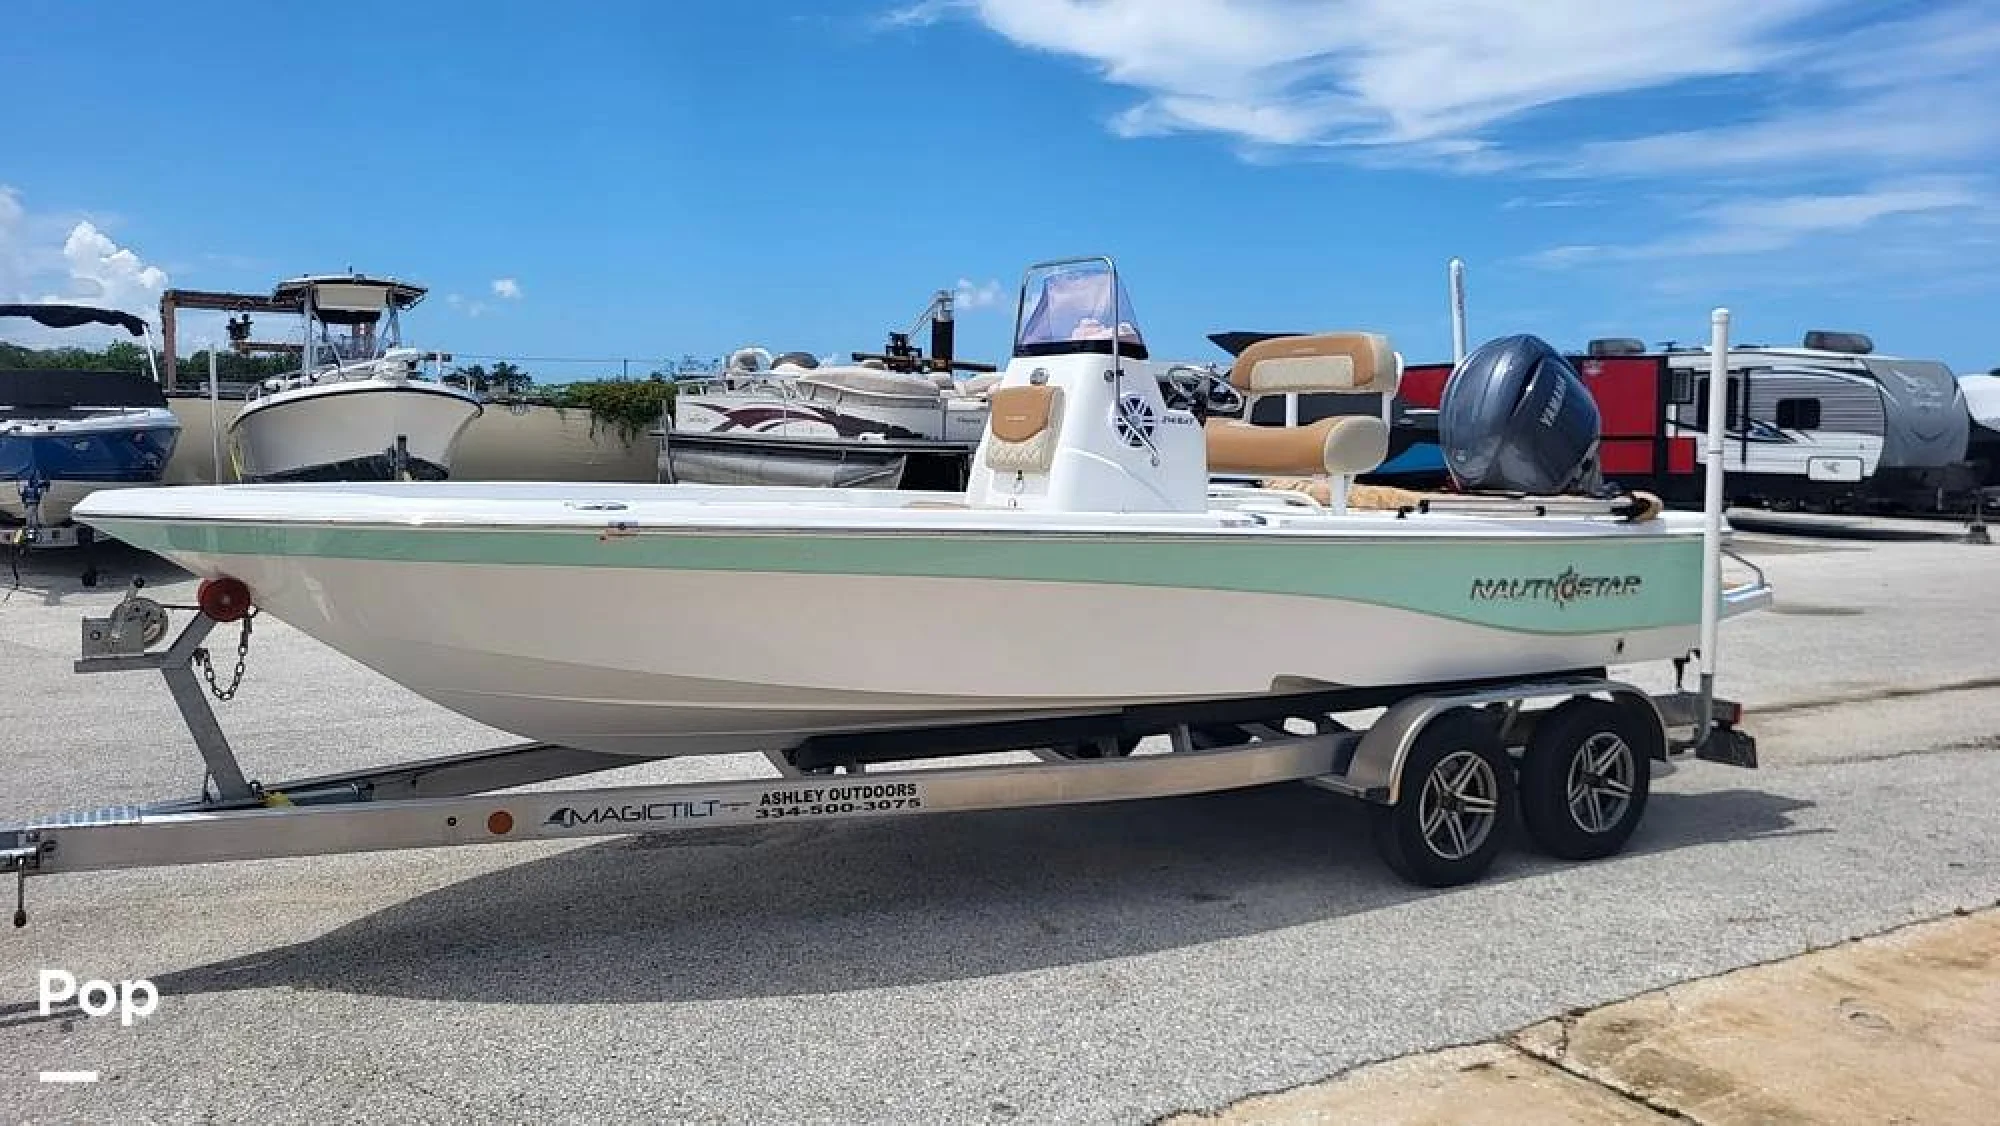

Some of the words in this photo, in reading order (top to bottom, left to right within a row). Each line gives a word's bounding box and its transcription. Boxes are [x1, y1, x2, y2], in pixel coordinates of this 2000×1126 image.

[1540, 373, 1566, 427] YAMAHA
[760, 789, 825, 806] ASHLEY
[829, 783, 917, 802] OUTDOORS
[569, 800, 721, 826] MAGICTILT
[755, 798, 921, 819] 334-500-3075
